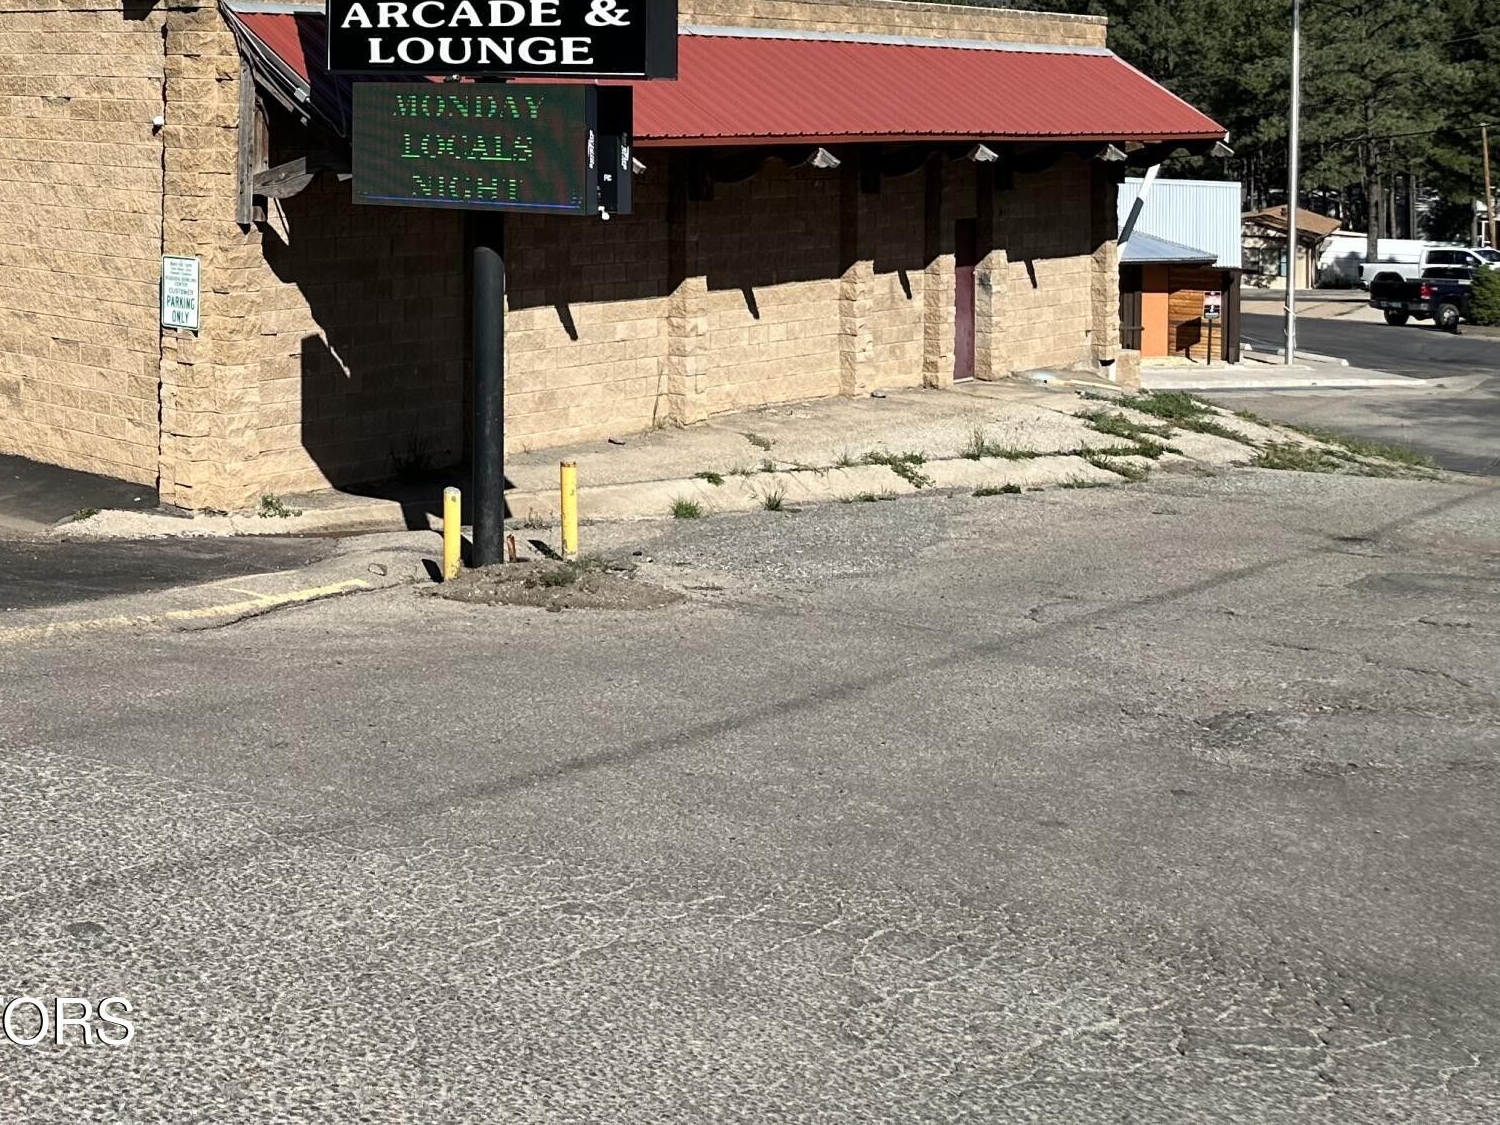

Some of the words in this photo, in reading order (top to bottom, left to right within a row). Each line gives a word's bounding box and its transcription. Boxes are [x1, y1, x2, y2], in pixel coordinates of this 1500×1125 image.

[368, 37, 594, 65] LOUNGE
[393, 95, 544, 119] MONDAY
[401, 133, 533, 162] LOCALS
[412, 175, 524, 200] NIGHT
[167, 295, 195, 310] PARKING
[172, 310, 189, 324] ONLY
